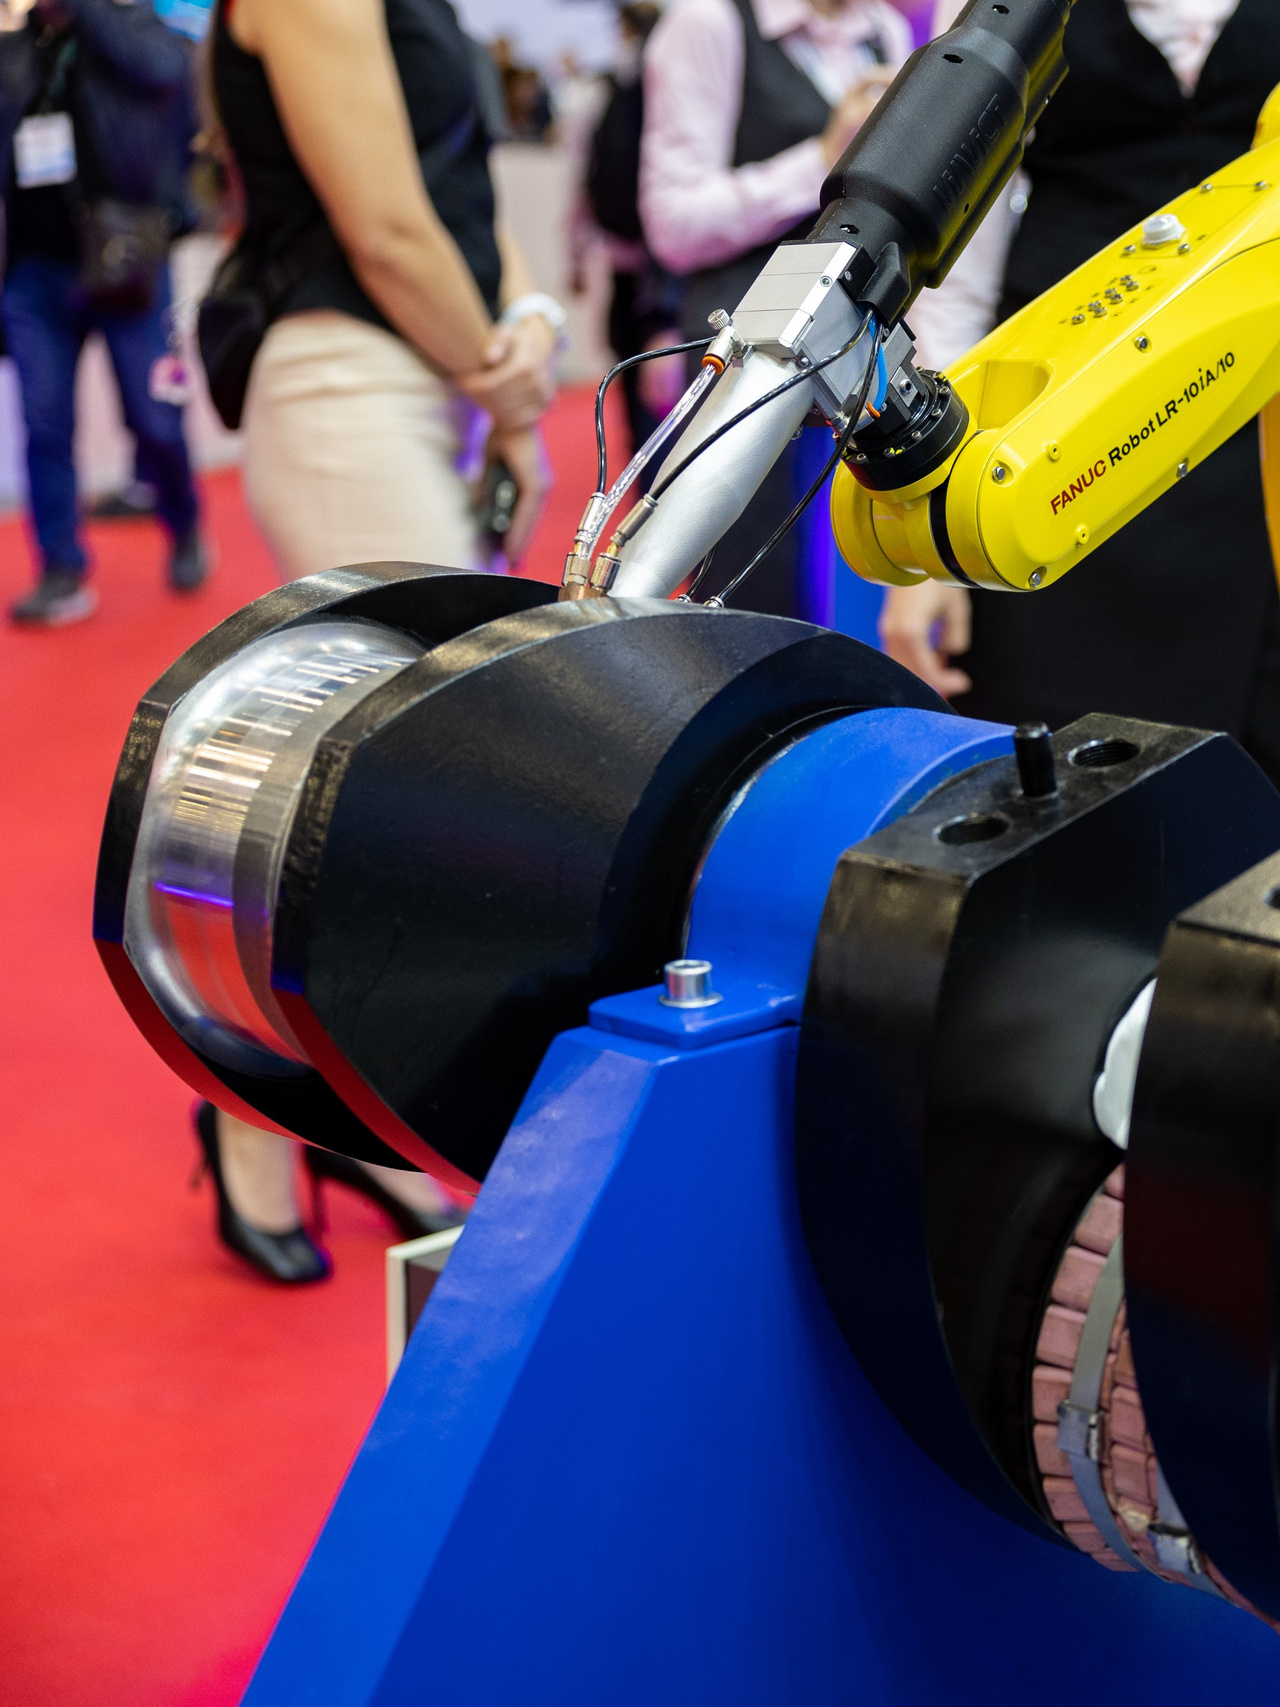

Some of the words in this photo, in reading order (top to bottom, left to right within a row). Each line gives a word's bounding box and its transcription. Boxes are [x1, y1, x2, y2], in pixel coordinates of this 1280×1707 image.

[1050, 459, 1107, 515] FANUC
[1108, 418, 1156, 466] Robot
[1156, 352, 1235, 427] LR-10iA/10
